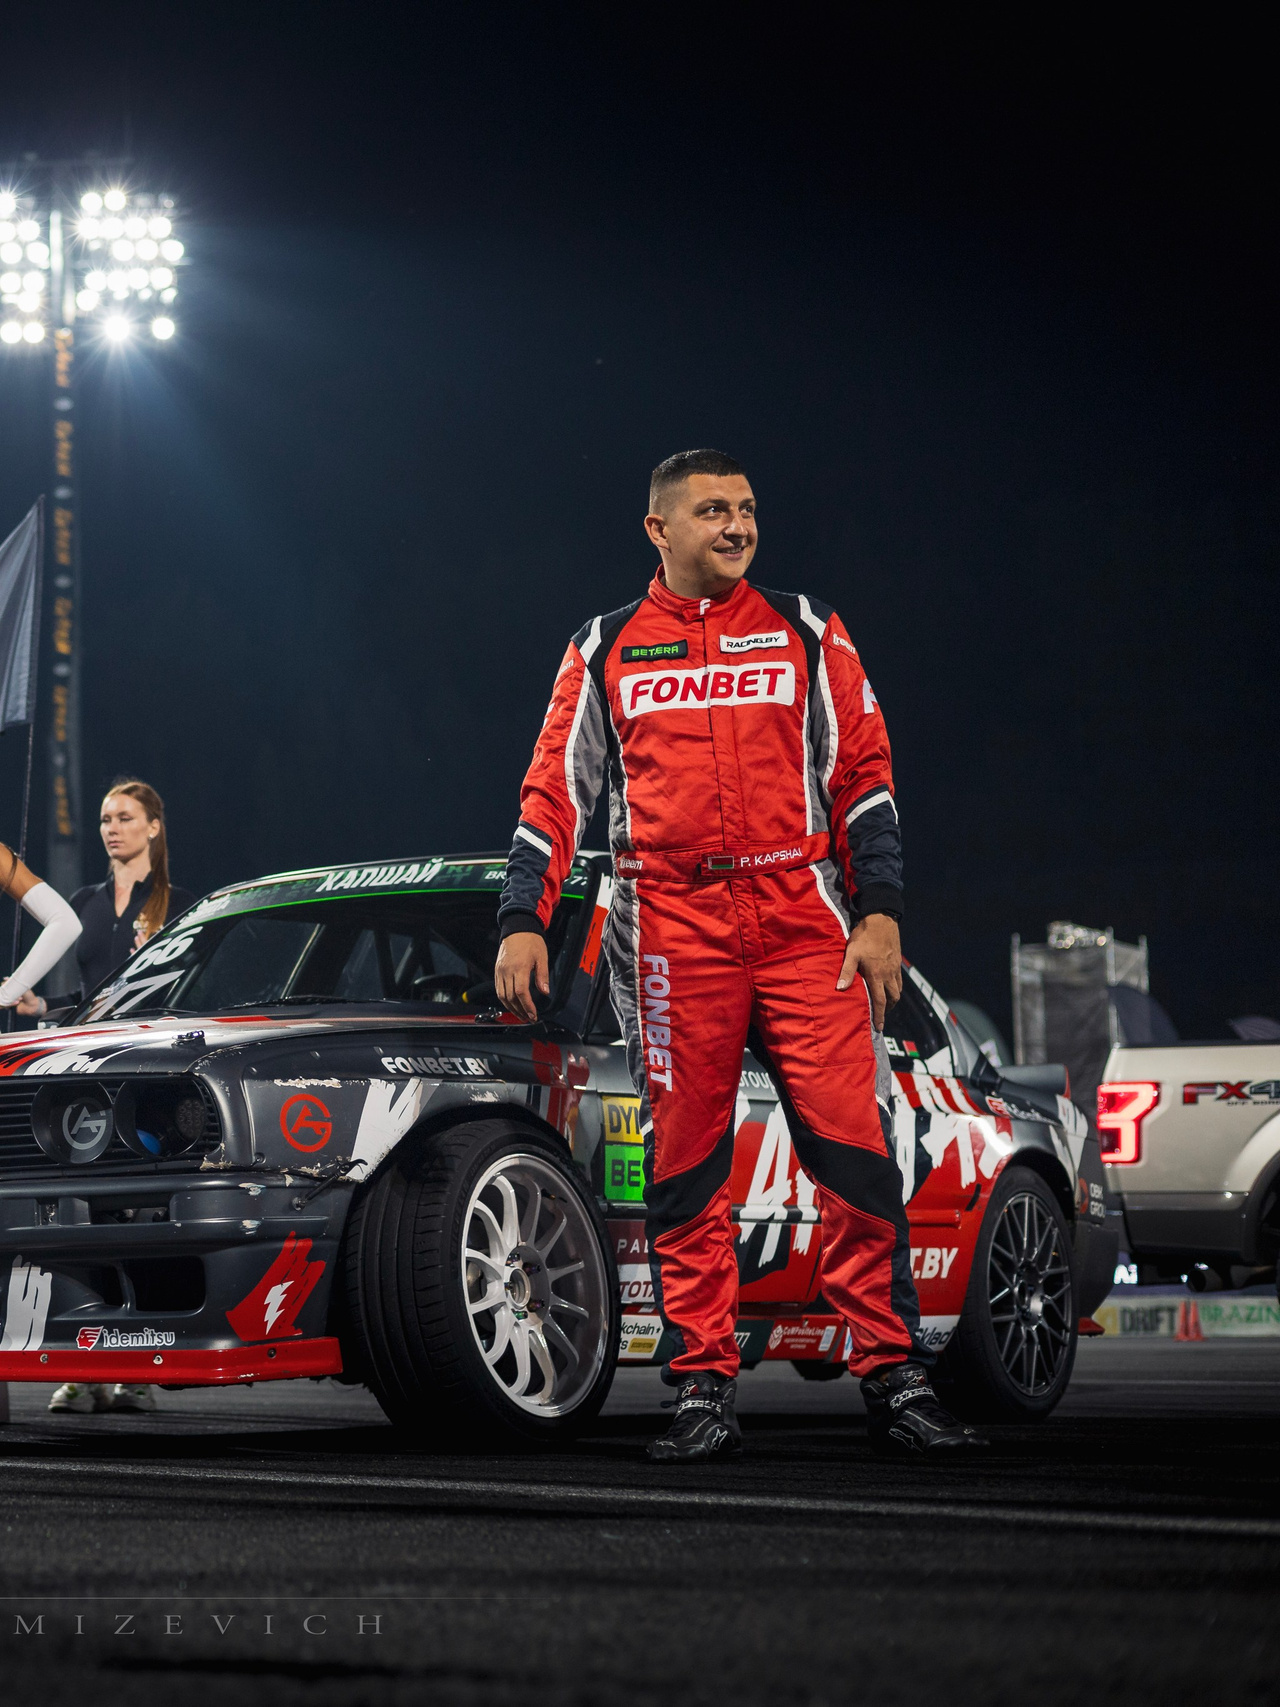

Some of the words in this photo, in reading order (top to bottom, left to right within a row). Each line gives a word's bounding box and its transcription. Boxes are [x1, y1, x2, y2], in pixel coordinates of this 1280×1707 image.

[630, 668, 786, 711] FONBET
[643, 954, 673, 1092] FONBET
[380, 1057, 494, 1076] FONBET.BY
[1182, 1080, 1280, 1106] FX4
[102, 1327, 175, 1347] idemitsu
